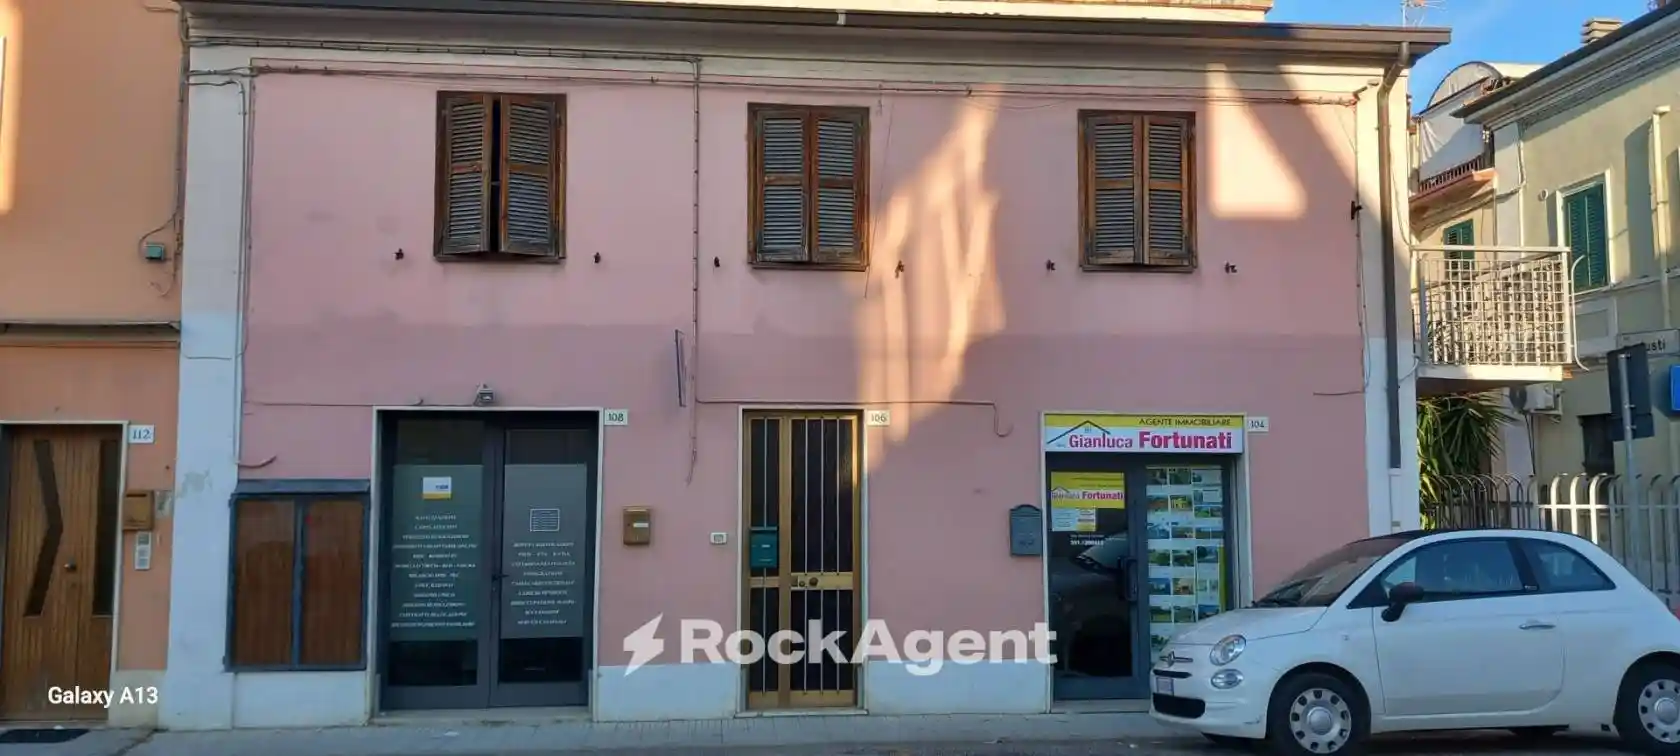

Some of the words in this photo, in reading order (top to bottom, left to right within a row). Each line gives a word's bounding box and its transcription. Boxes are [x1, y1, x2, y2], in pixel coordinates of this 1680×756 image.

[607, 412, 624, 422] 108
[870, 413, 888, 423] 106
[1139, 418, 1173, 426] AGENTE
[1175, 418, 1231, 426] IMMOBILIARE
[1250, 420, 1265, 429] 104
[132, 429, 151, 440] 112
[1069, 432, 1133, 449] Gianluca
[1138, 430, 1232, 449] Fortunati
[1082, 490, 1124, 500] Fortunati
